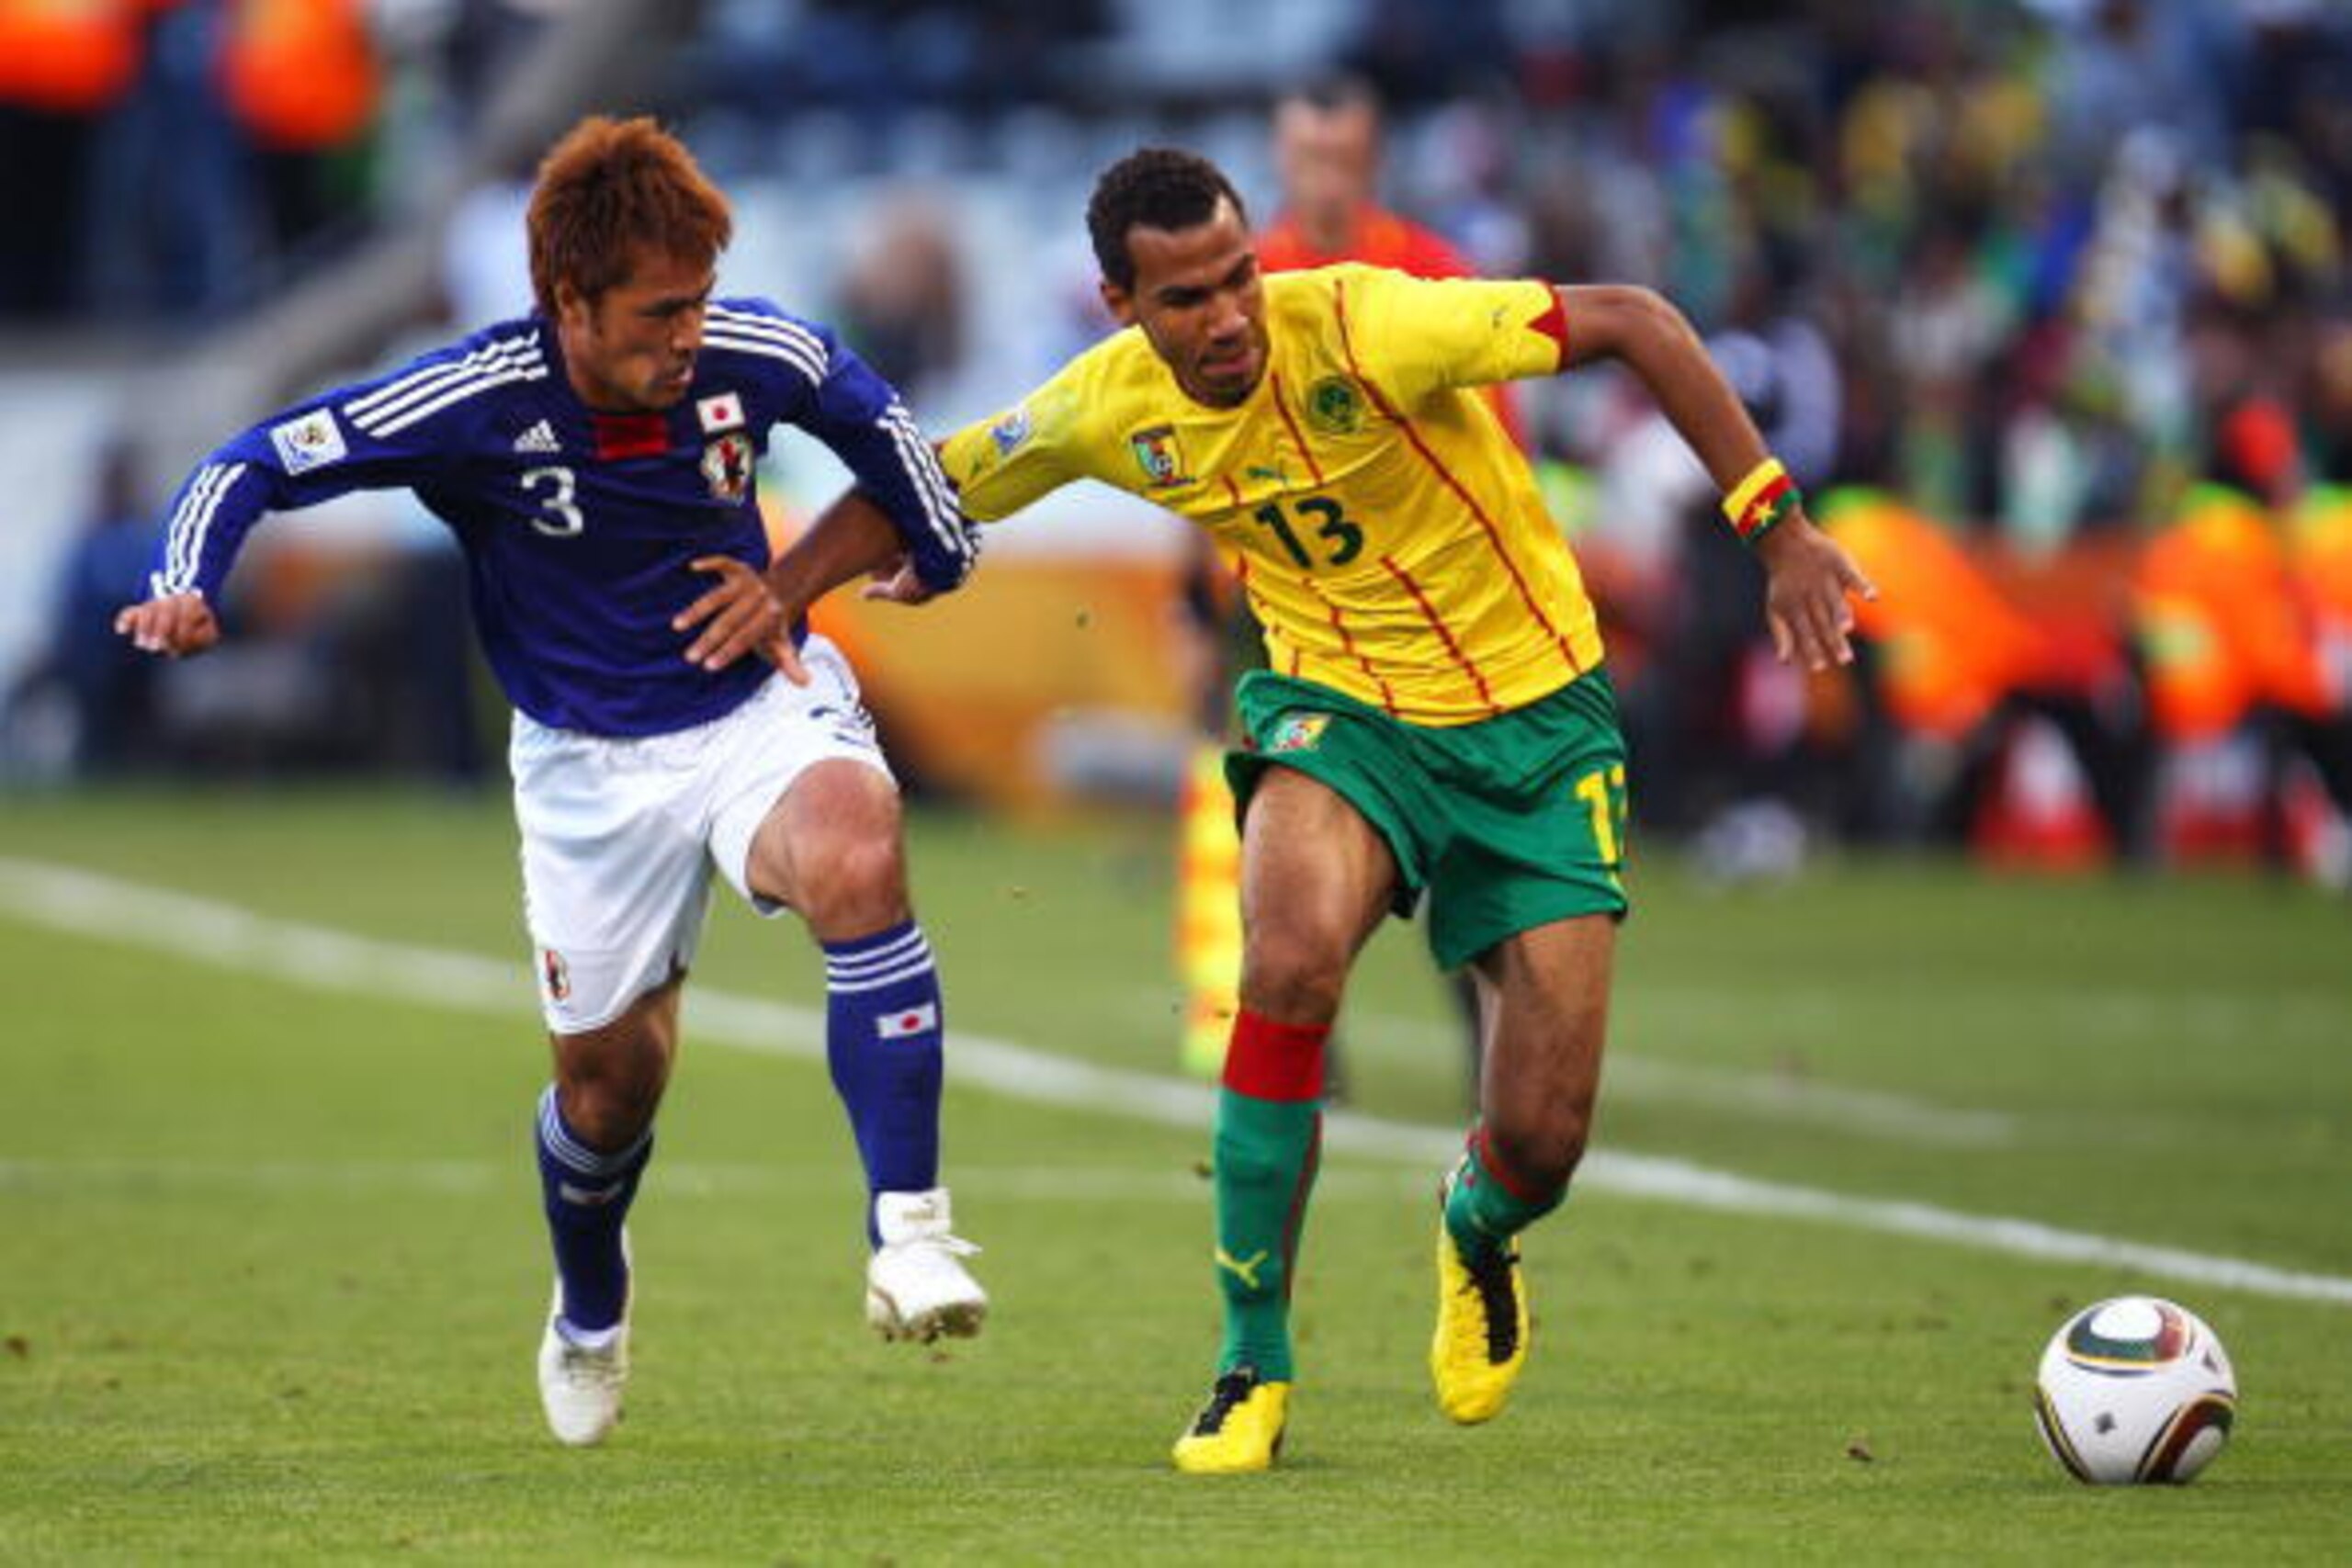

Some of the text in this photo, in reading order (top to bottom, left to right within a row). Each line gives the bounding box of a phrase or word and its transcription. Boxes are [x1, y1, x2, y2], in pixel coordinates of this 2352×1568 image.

[521, 467, 583, 535] 3
[1256, 496, 1363, 570] 13
[1576, 762, 1627, 864] 1
